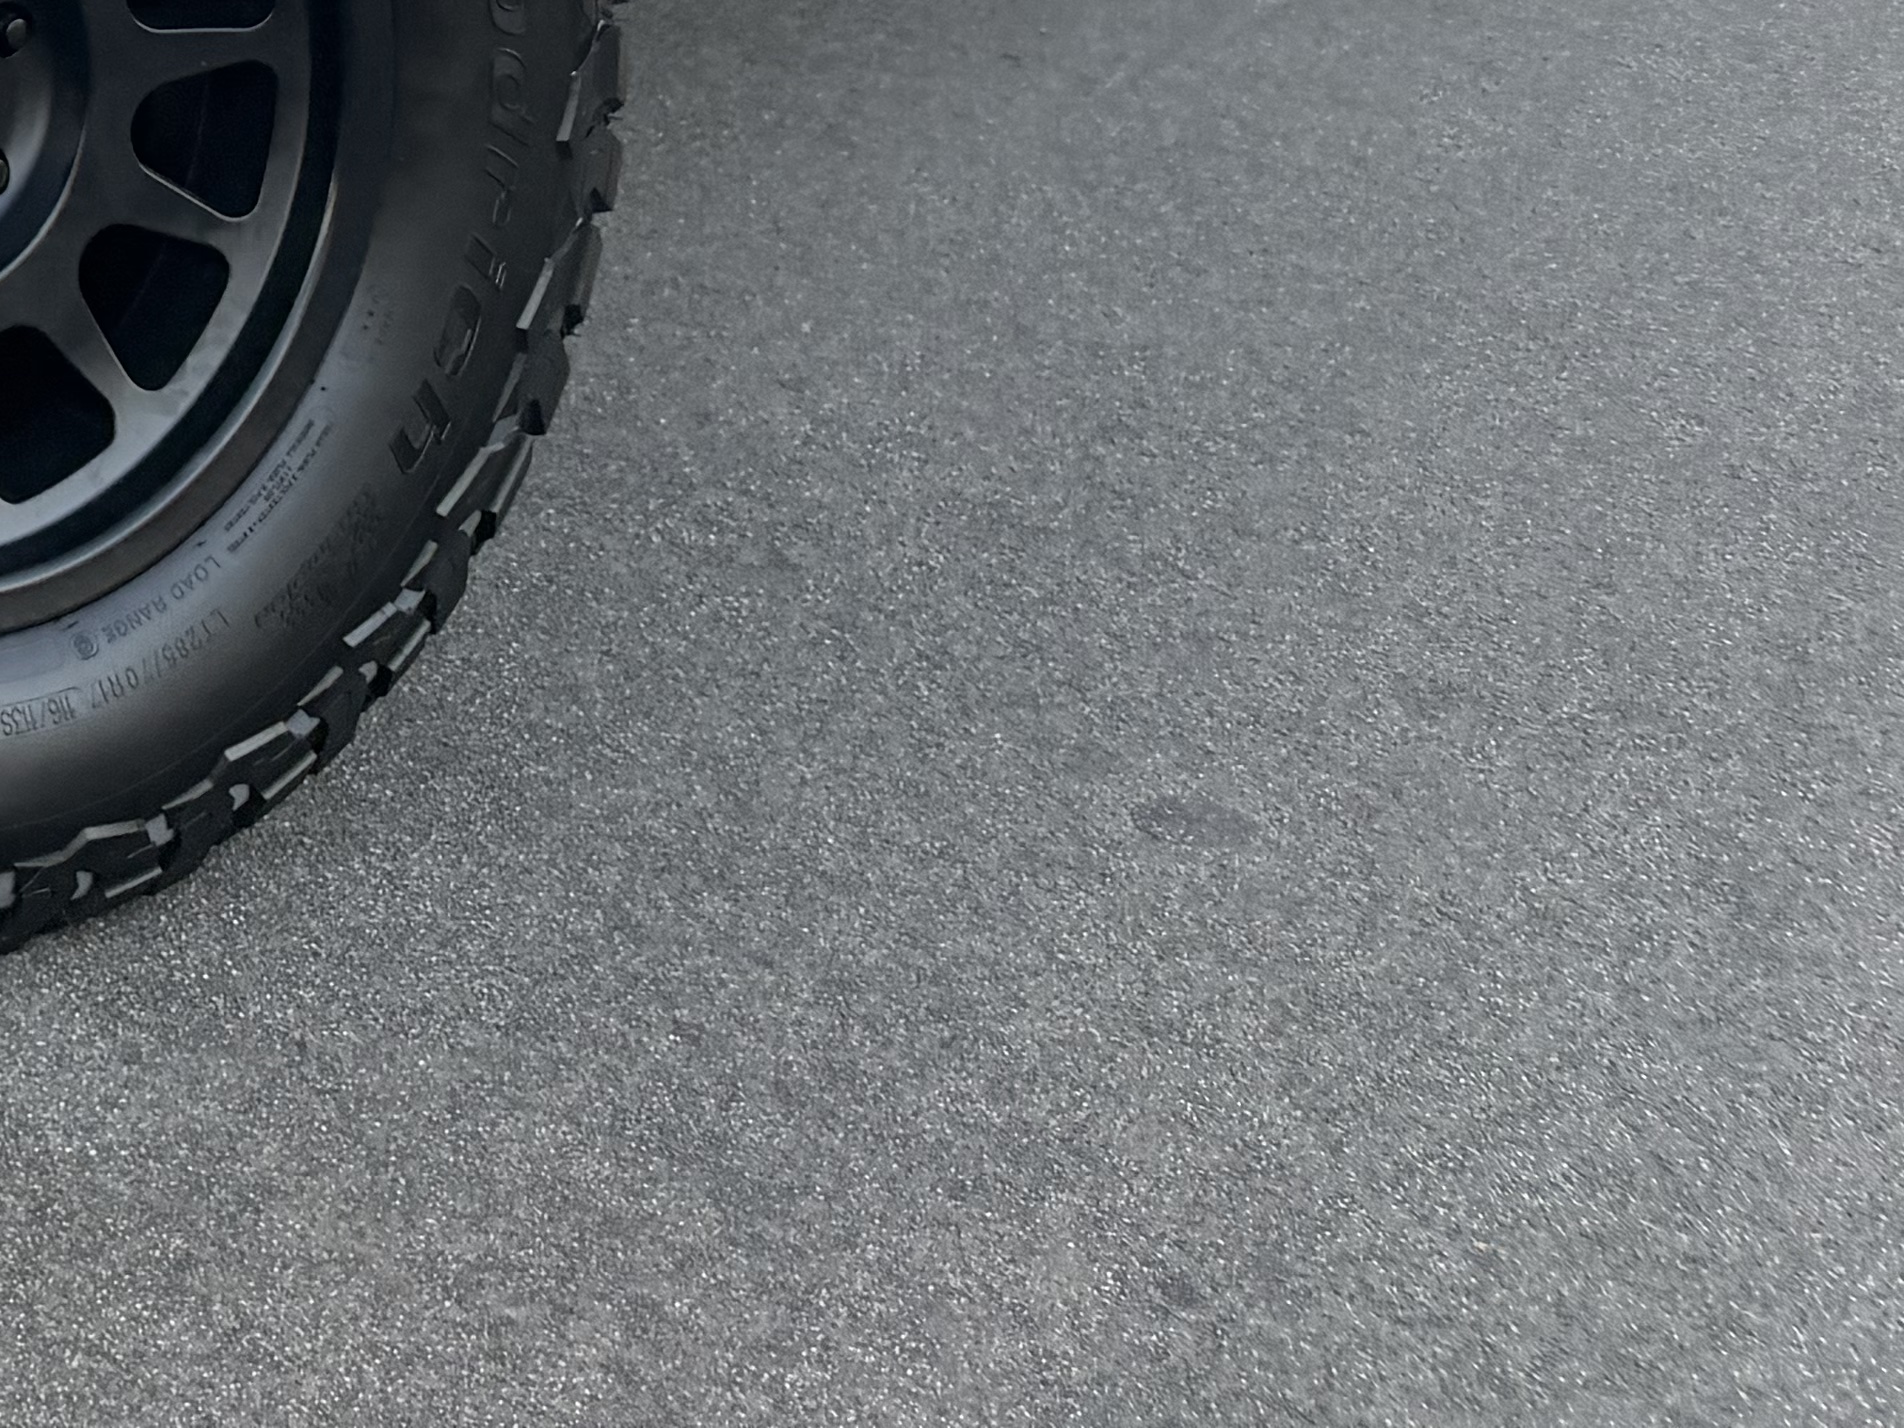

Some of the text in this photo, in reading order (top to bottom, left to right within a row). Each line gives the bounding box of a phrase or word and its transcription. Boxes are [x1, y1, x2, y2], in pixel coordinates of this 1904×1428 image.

[170, 554, 221, 601] LOAD
[103, 595, 167, 645] RANGE
[0, 693, 75, 738] 116/113S
